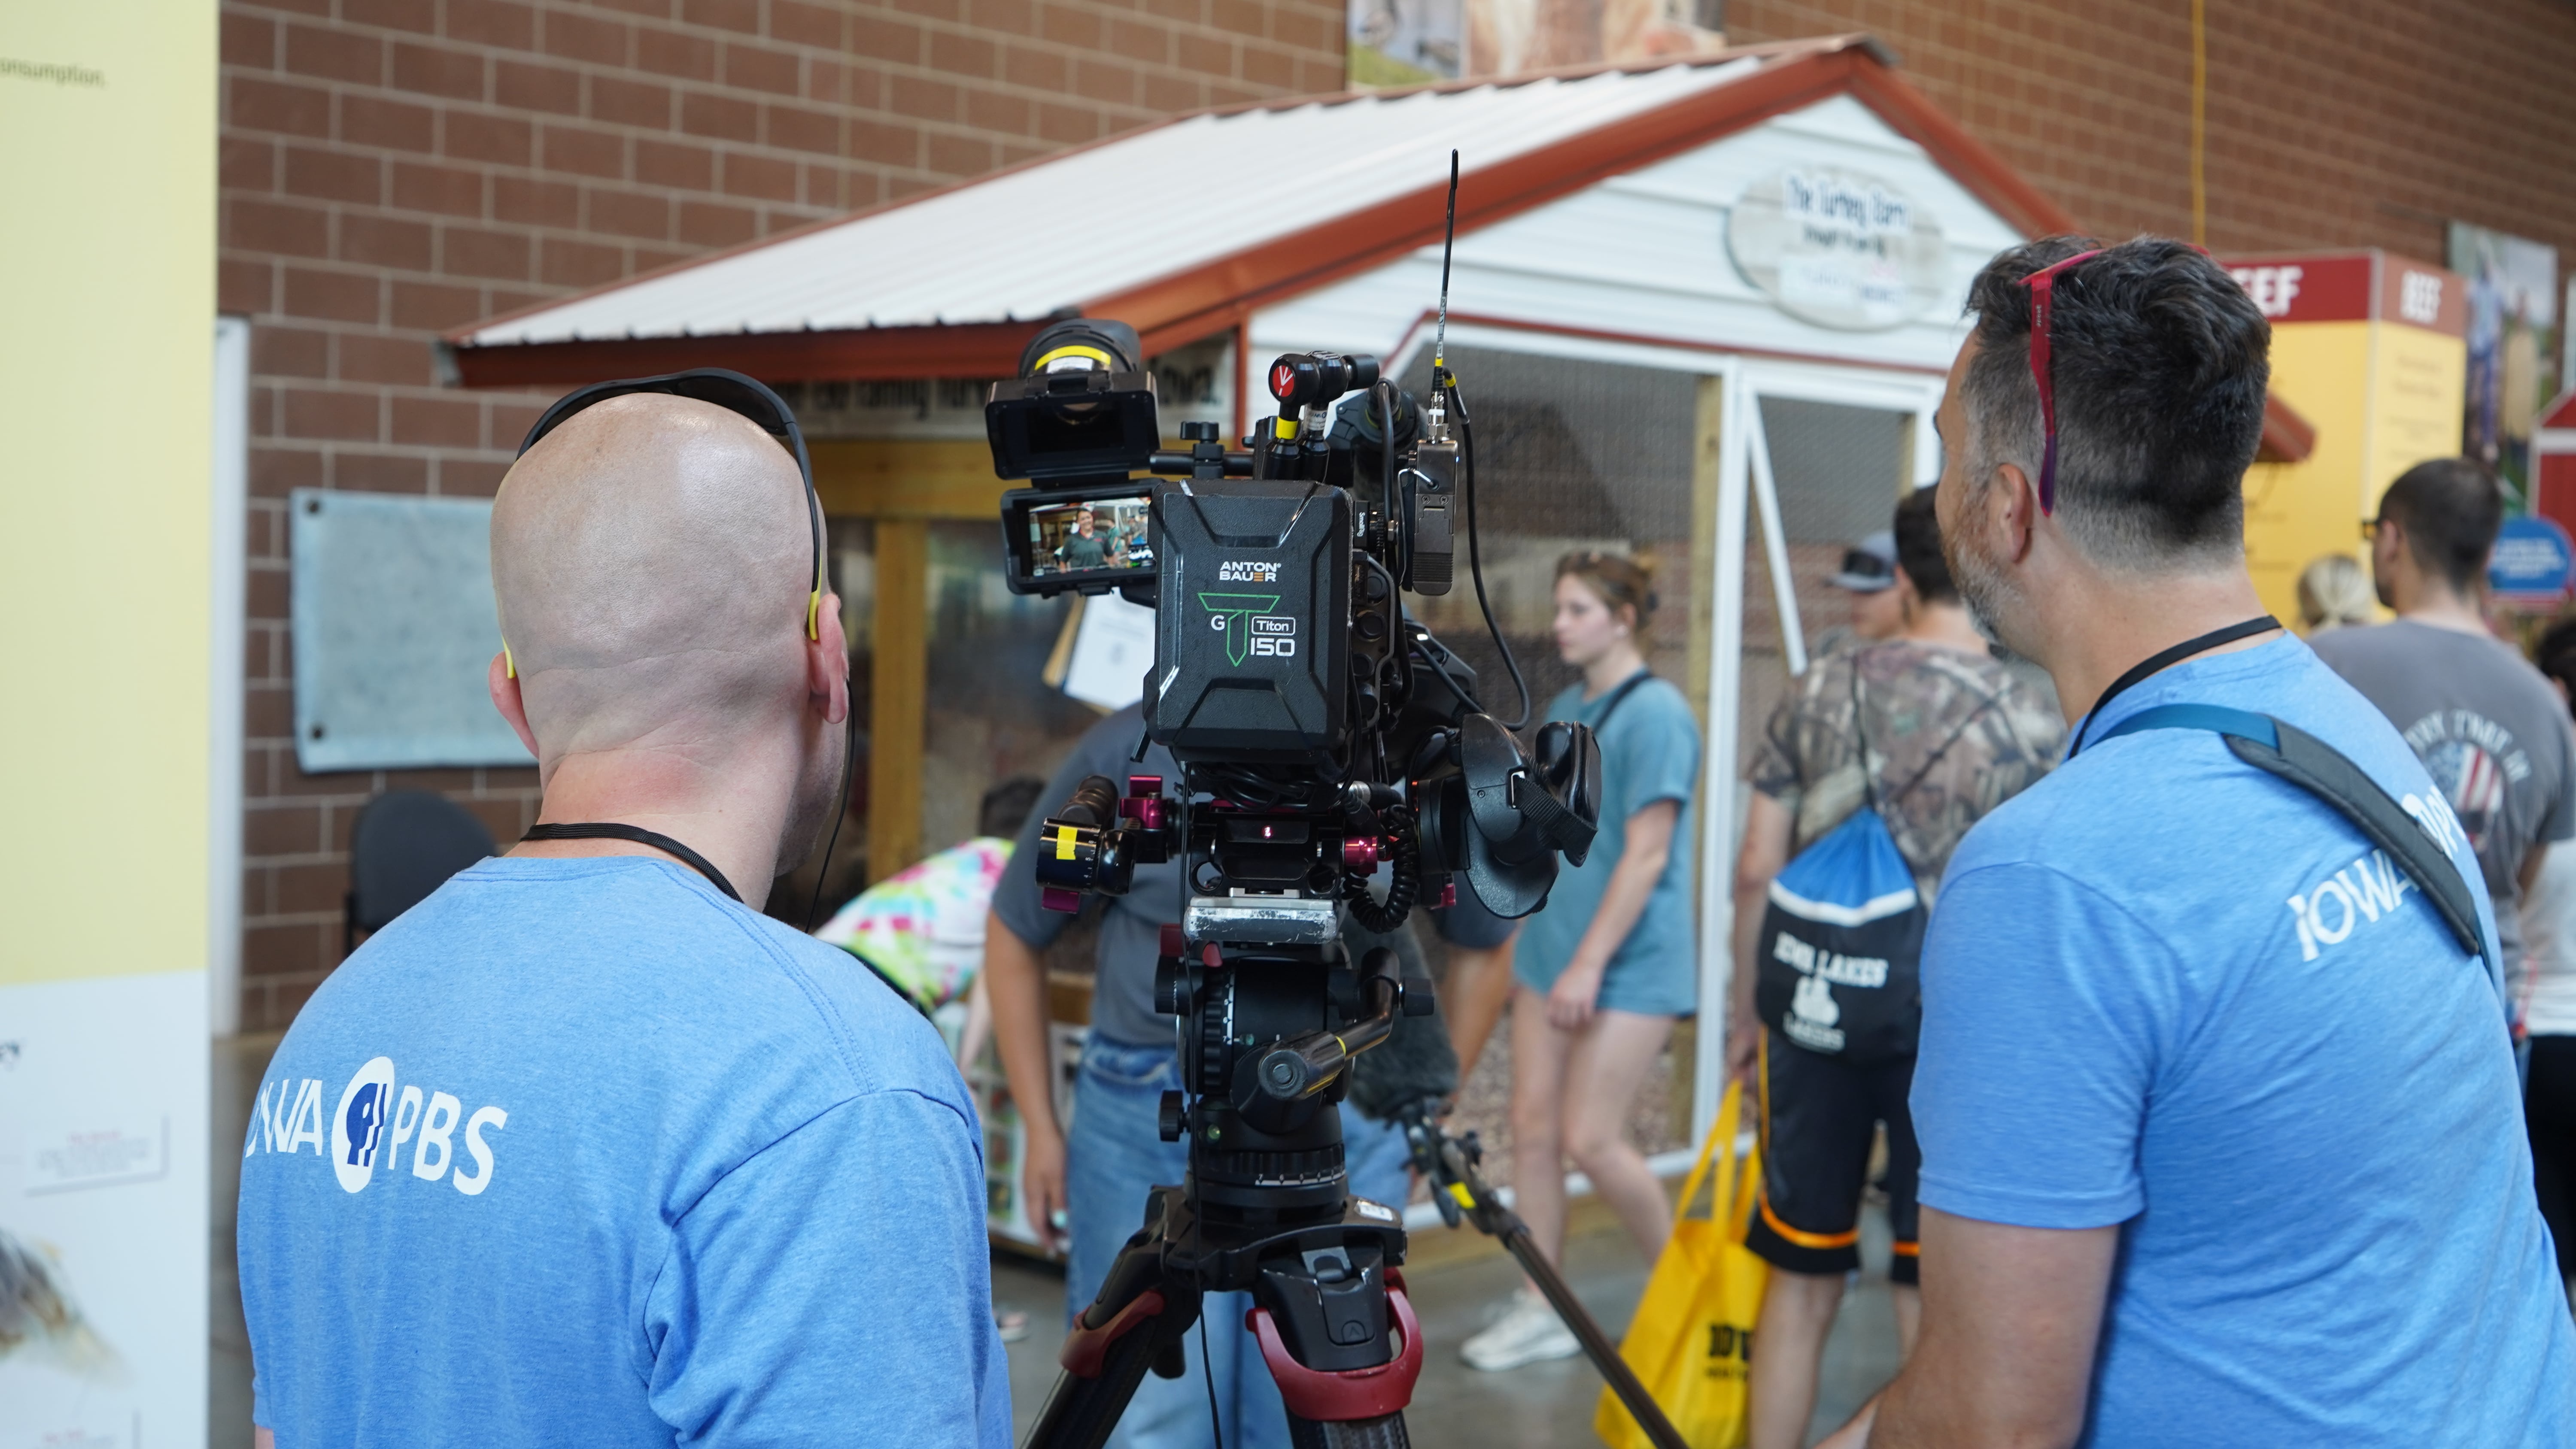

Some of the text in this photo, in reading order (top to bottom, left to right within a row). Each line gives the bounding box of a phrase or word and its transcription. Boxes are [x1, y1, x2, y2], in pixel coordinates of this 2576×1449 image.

[1220, 561, 1277, 572] ANTON
[1219, 570, 1277, 582] BAUER
[1250, 637, 1295, 657] 150
[389, 1085, 508, 1195] PBS
